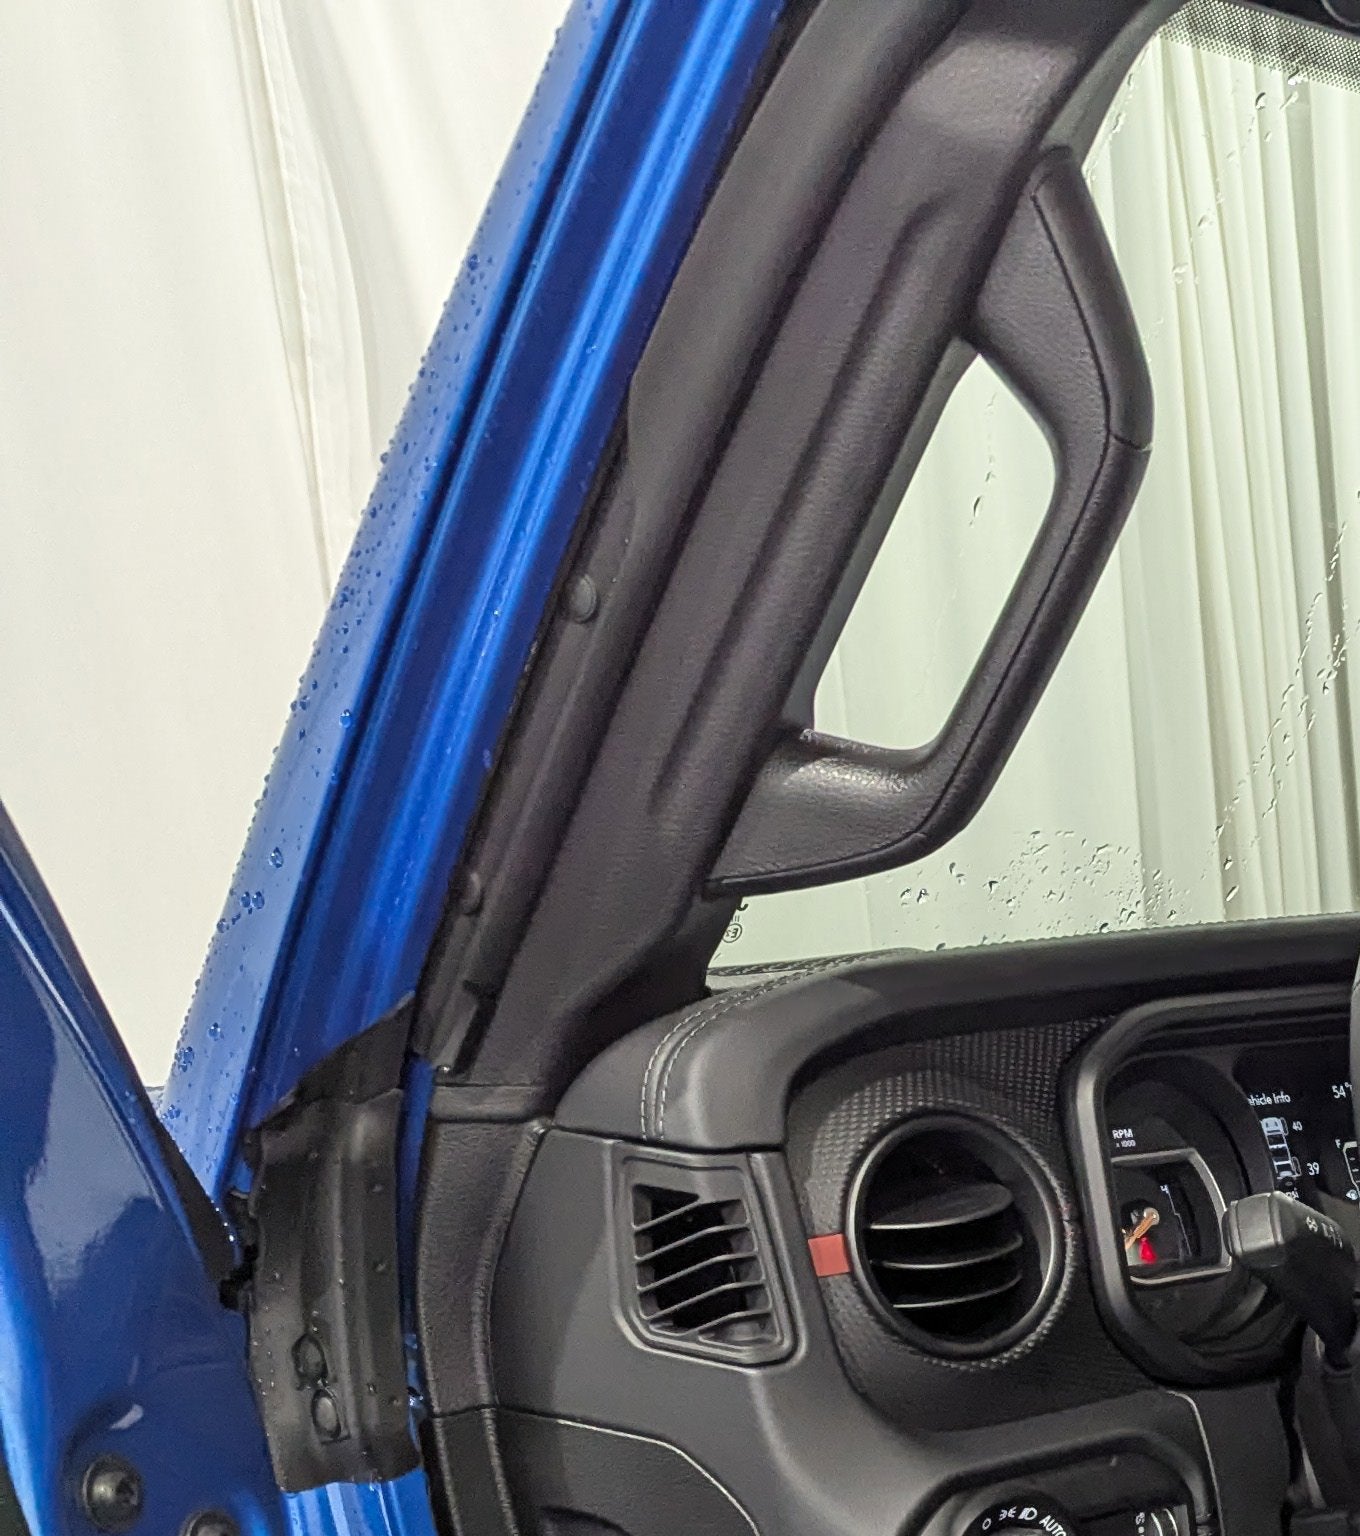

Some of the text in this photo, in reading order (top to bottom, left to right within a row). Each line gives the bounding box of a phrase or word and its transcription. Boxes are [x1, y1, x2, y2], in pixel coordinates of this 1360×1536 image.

[1272, 1091, 1291, 1105] Info
[1292, 1120, 1303, 1132] 40
[1112, 1128, 1134, 1140] RPM
[1306, 1162, 1320, 1175] 39
